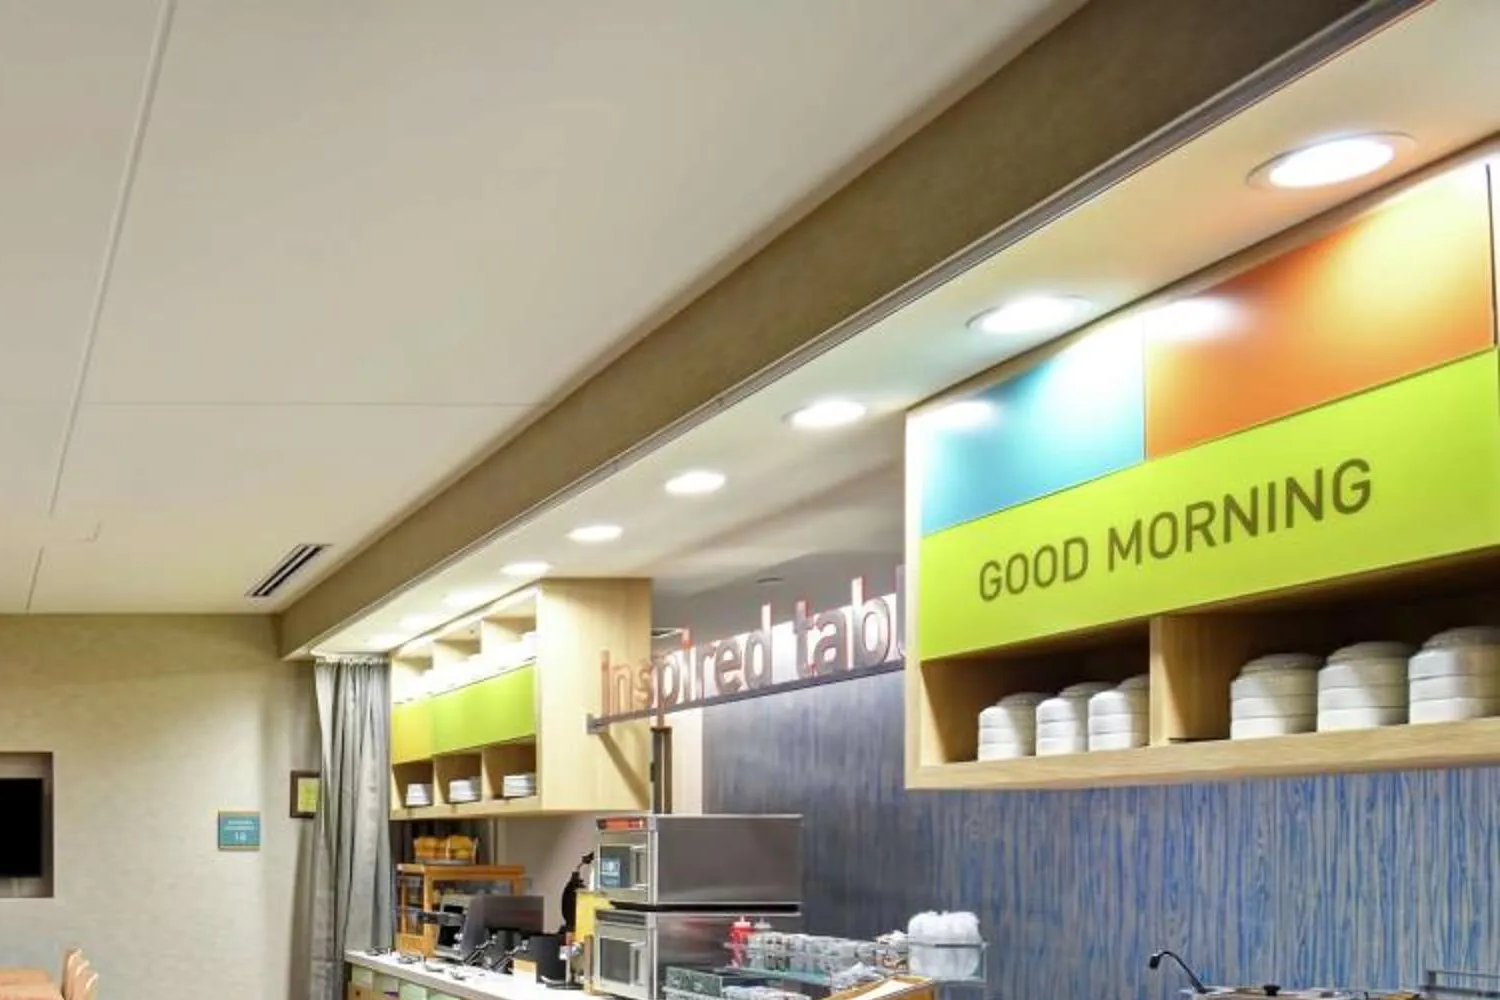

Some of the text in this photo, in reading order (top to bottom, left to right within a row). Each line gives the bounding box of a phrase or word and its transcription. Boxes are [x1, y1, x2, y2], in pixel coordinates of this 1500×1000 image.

[978, 457, 1372, 602] GOOD MORNING
[601, 603, 773, 728] inspired
